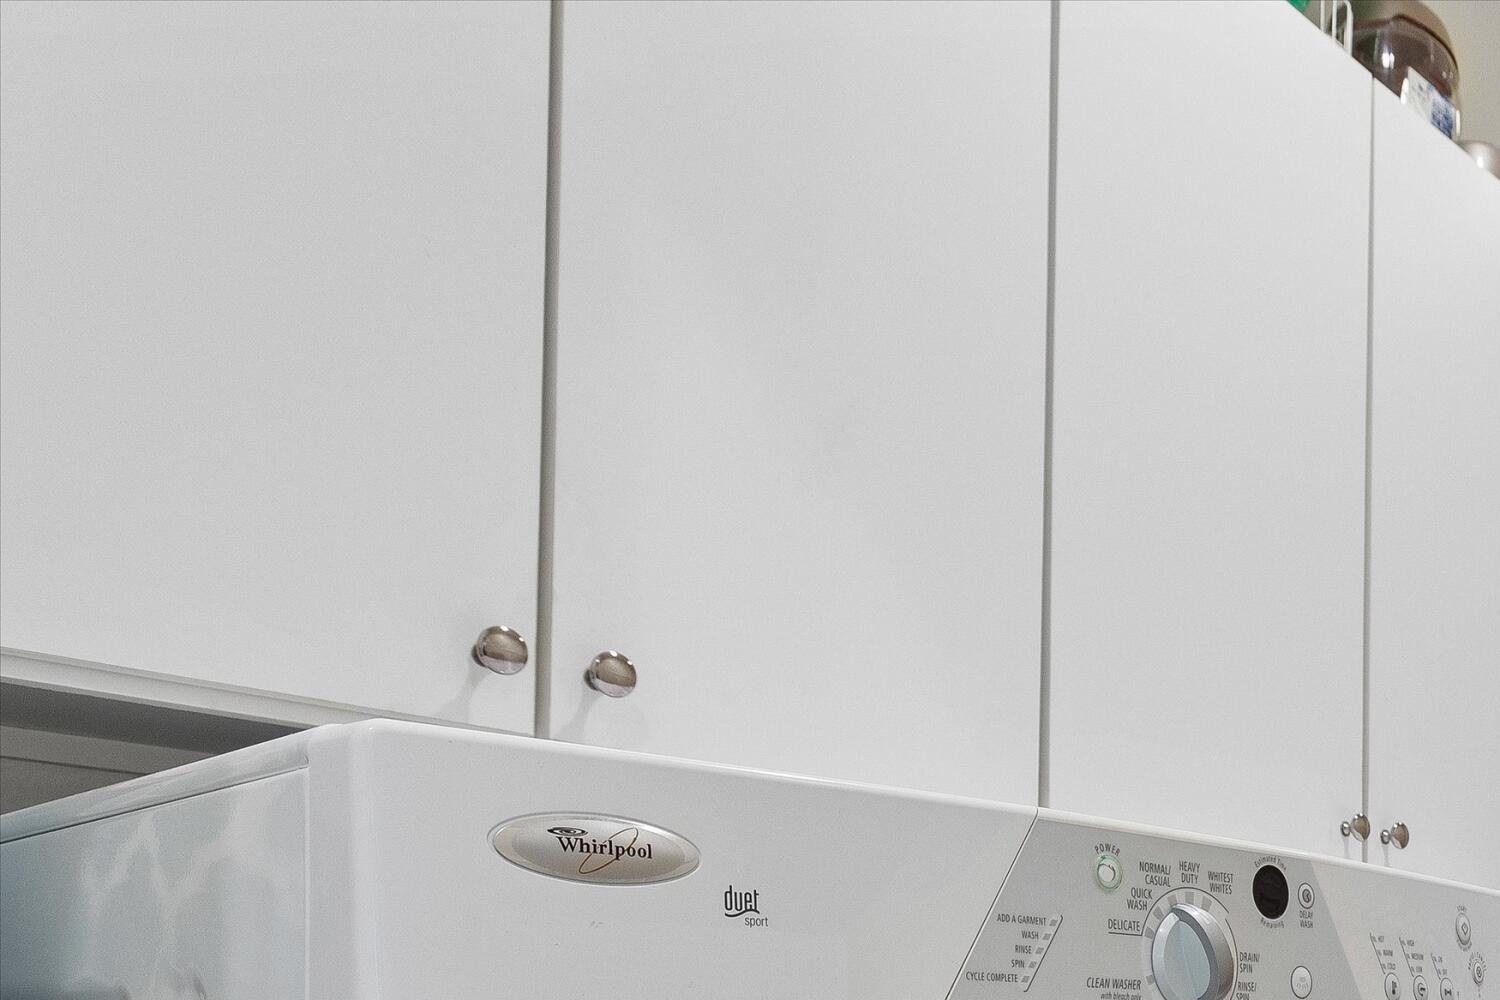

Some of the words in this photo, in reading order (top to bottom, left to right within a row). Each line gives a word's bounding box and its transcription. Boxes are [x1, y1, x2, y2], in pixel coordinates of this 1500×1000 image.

[556, 836, 652, 860] Whirlpool
[1094, 843, 1120, 856] POWER
[1139, 861, 1172, 875] NORMAL/
[1179, 861, 1201, 873] HEAVY
[1145, 874, 1171, 887] CASUAL
[1181, 872, 1199, 884] DUTY
[1208, 871, 1233, 883] WHITEST
[1130, 887, 1153, 899] QUICK
[1209, 883, 1233, 895] WHITES
[724, 884, 760, 912] duet
[1126, 899, 1148, 911] WASH
[744, 917, 769, 928] sport
[997, 913, 1010, 923] ADD
[1010, 914, 1016, 923] A
[1017, 915, 1047, 926] GARMENT
[1108, 918, 1141, 931] DELICATE
[1021, 930, 1039, 940] WASH
[1014, 945, 1032, 954] RINSE
[1239, 952, 1260, 962] DRAIN/
[1011, 959, 1025, 969] SPIN
[1239, 963, 1253, 973] SPIN
[966, 971, 985, 981] CYCLE
[986, 972, 1018, 982] COMPLETE
[1086, 976, 1110, 989] CLEAN
[1112, 979, 1142, 990] WASHER
[1237, 982, 1257, 992] RINSE/
[1100, 992, 1112, 1000] with
[1113, 992, 1130, 1000] bleach
